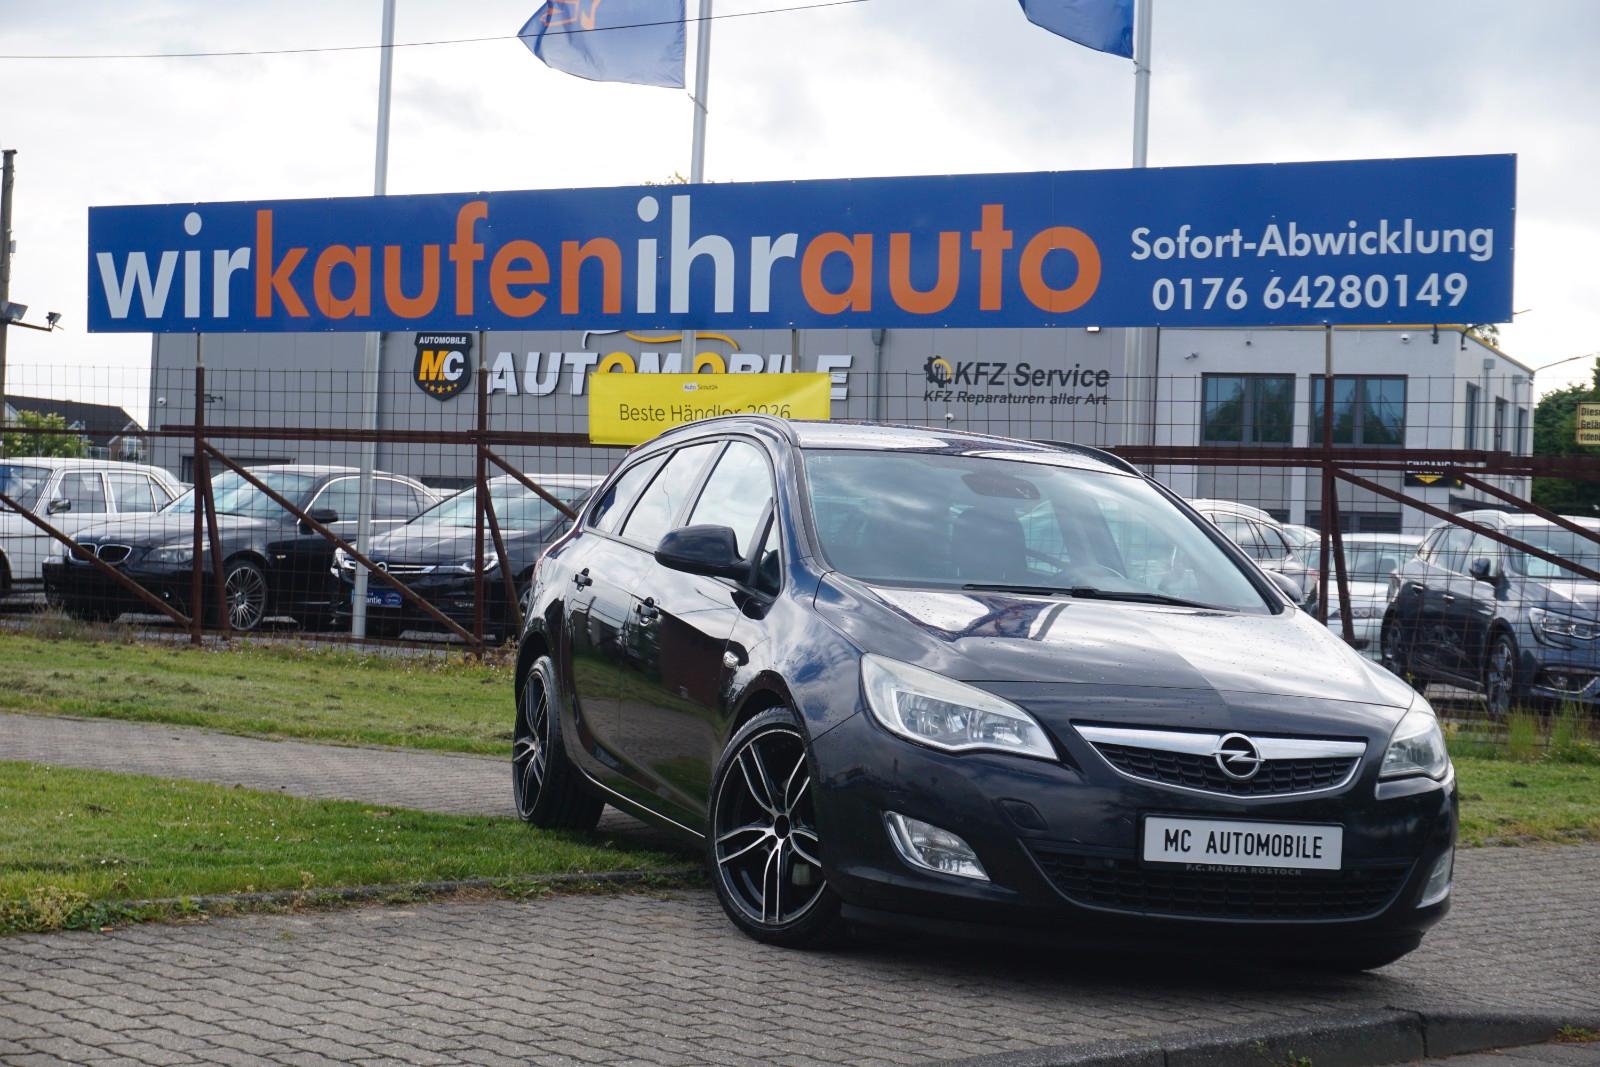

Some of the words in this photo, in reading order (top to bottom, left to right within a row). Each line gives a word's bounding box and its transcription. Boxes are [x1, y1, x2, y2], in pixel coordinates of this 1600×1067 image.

[1131, 219, 1493, 261] Sofort-Abwicklung
[1152, 277, 1248, 311] 0176
[1263, 272, 1468, 310] 64280149
[419, 336, 467, 345] AUTOMOBILE
[419, 350, 464, 381] MC
[954, 361, 1008, 386] KFZ
[1013, 362, 1110, 388] Service
[923, 390, 953, 402] KFZ
[956, 391, 1045, 405] Reparaturen
[1050, 393, 1081, 404] aller
[1084, 394, 1108, 405] Art
[619, 403, 665, 421] Beste
[1164, 829, 1192, 852] MC
[1205, 831, 1323, 858] AUTOMOBILE
[1185, 863, 1205, 872] F.C.
[1208, 865, 1247, 873] HANSA
[1251, 867, 1302, 876] ROSTOCK
